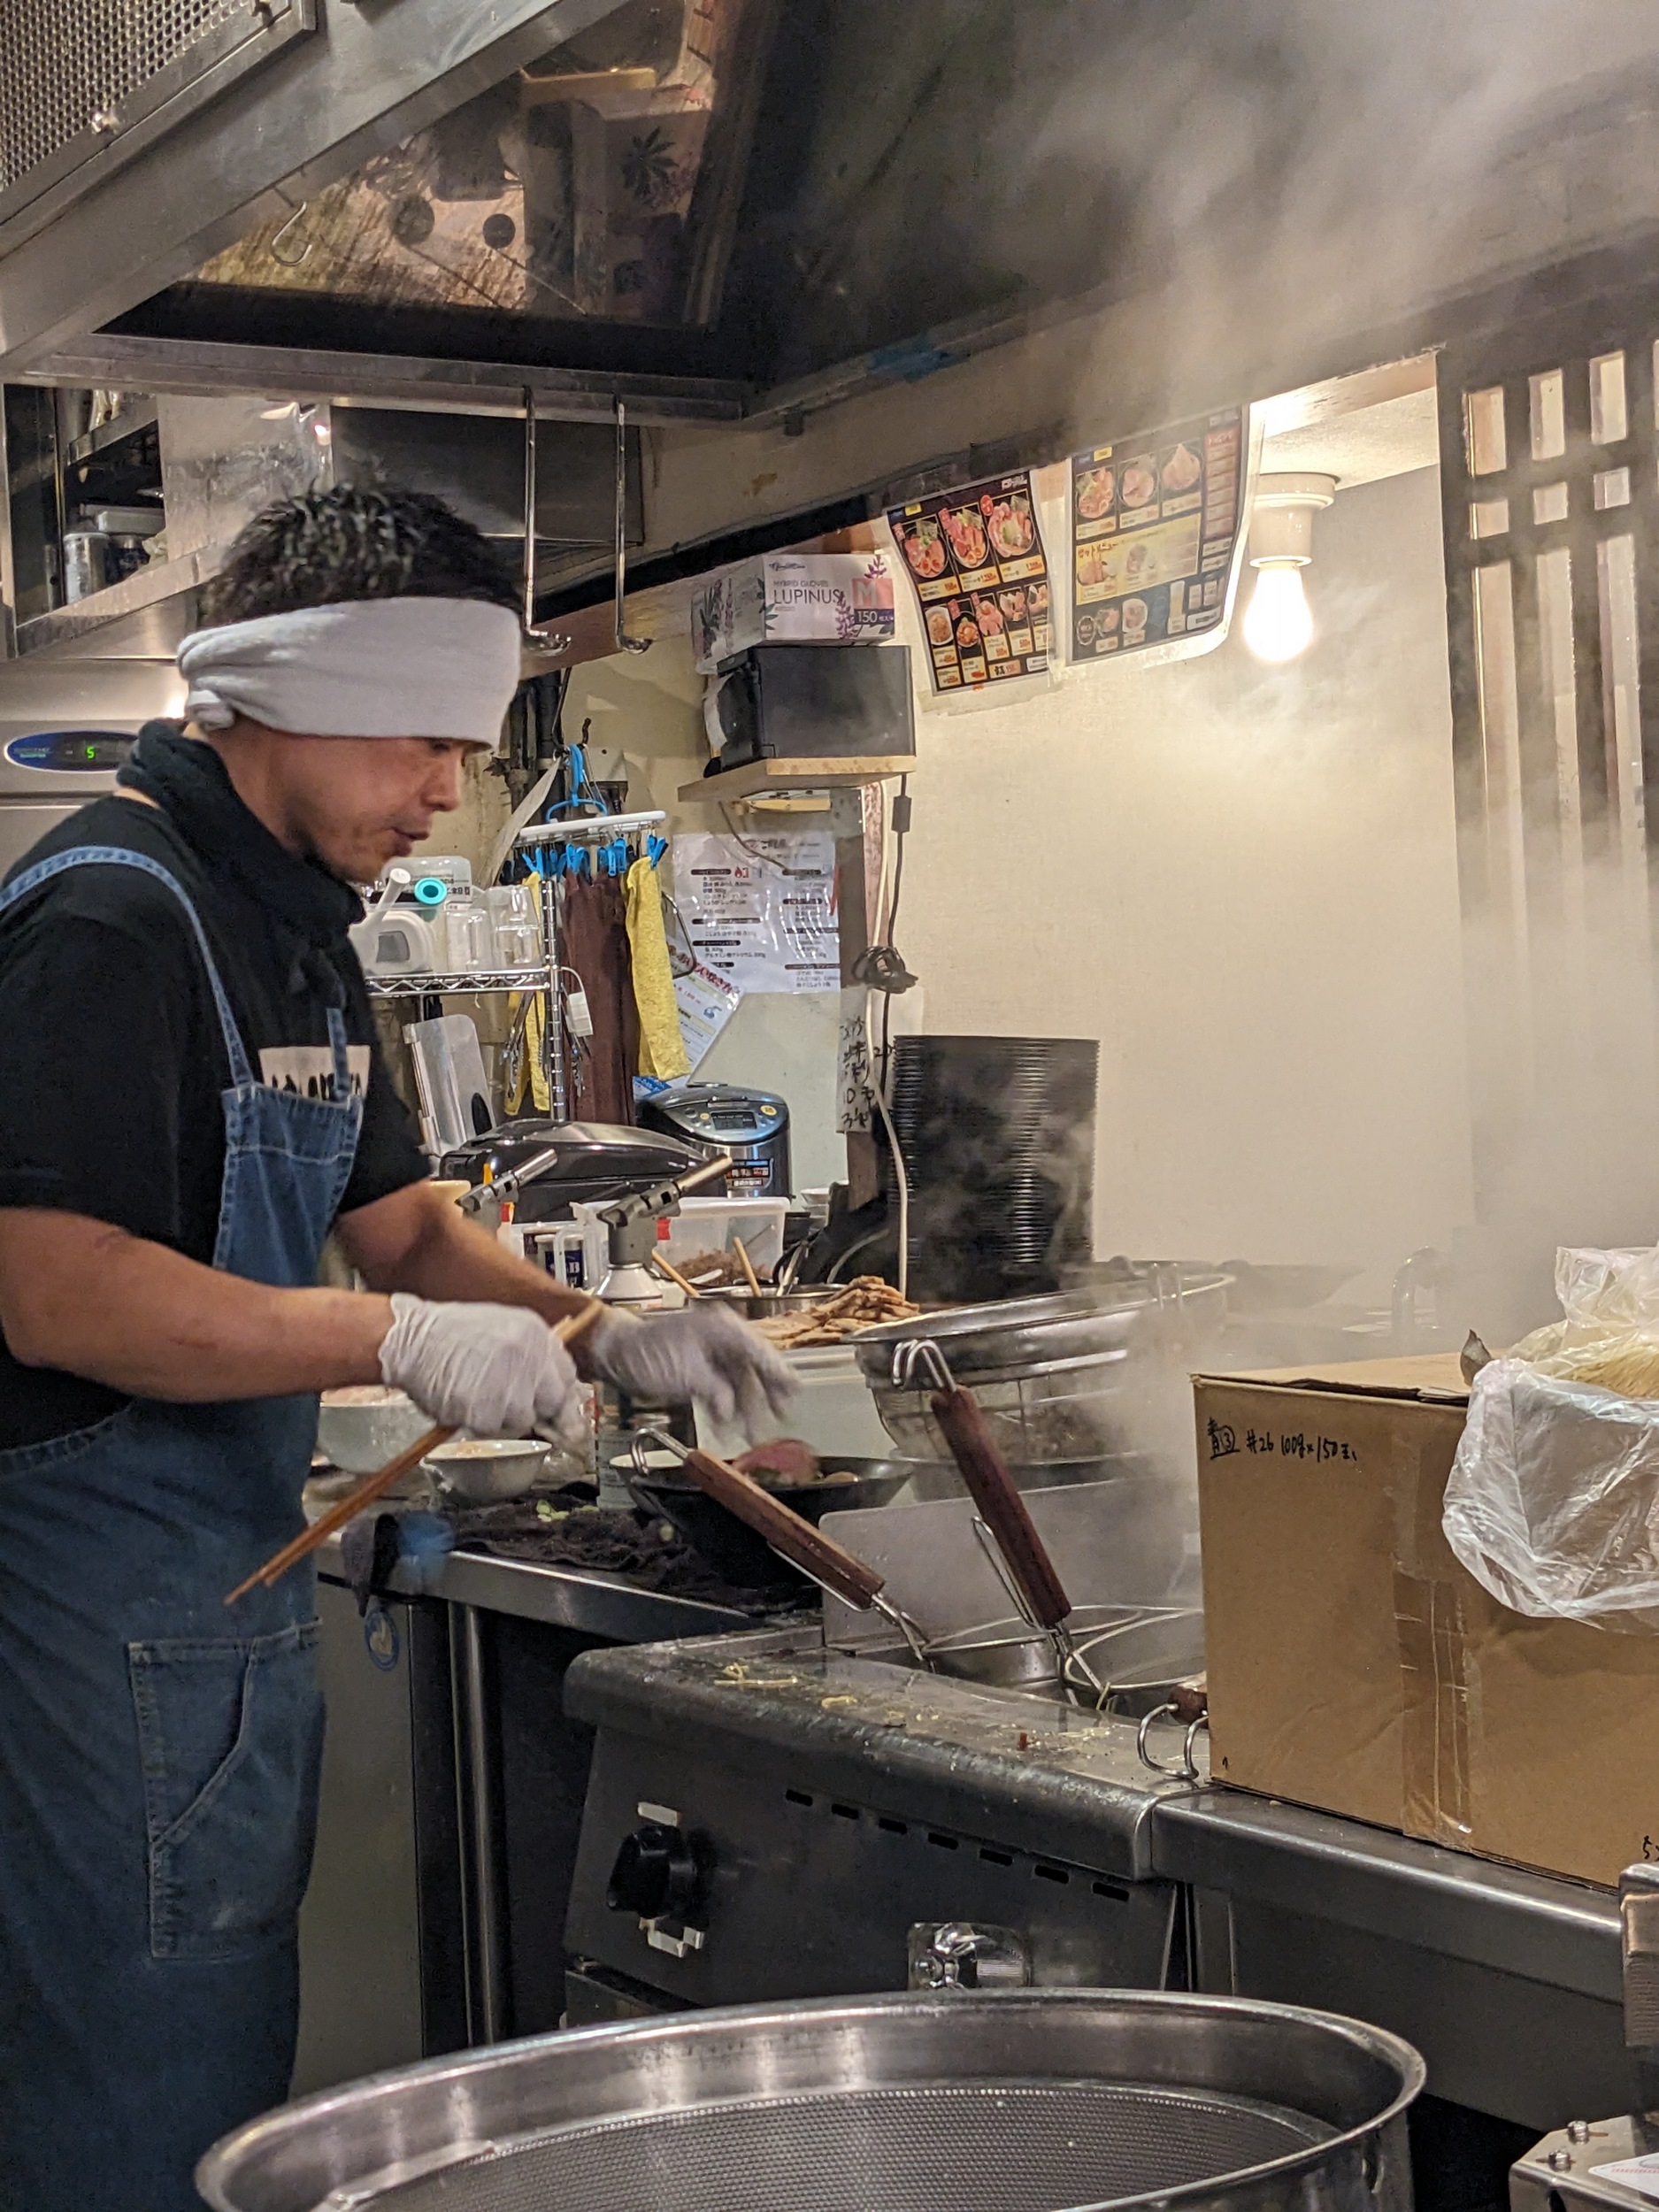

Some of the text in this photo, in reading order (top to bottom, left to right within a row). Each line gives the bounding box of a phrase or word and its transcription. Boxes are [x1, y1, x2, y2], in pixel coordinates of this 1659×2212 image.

[773, 588, 840, 604] LUPINUS
[857, 580, 877, 608] M
[858, 611, 878, 624] 150
